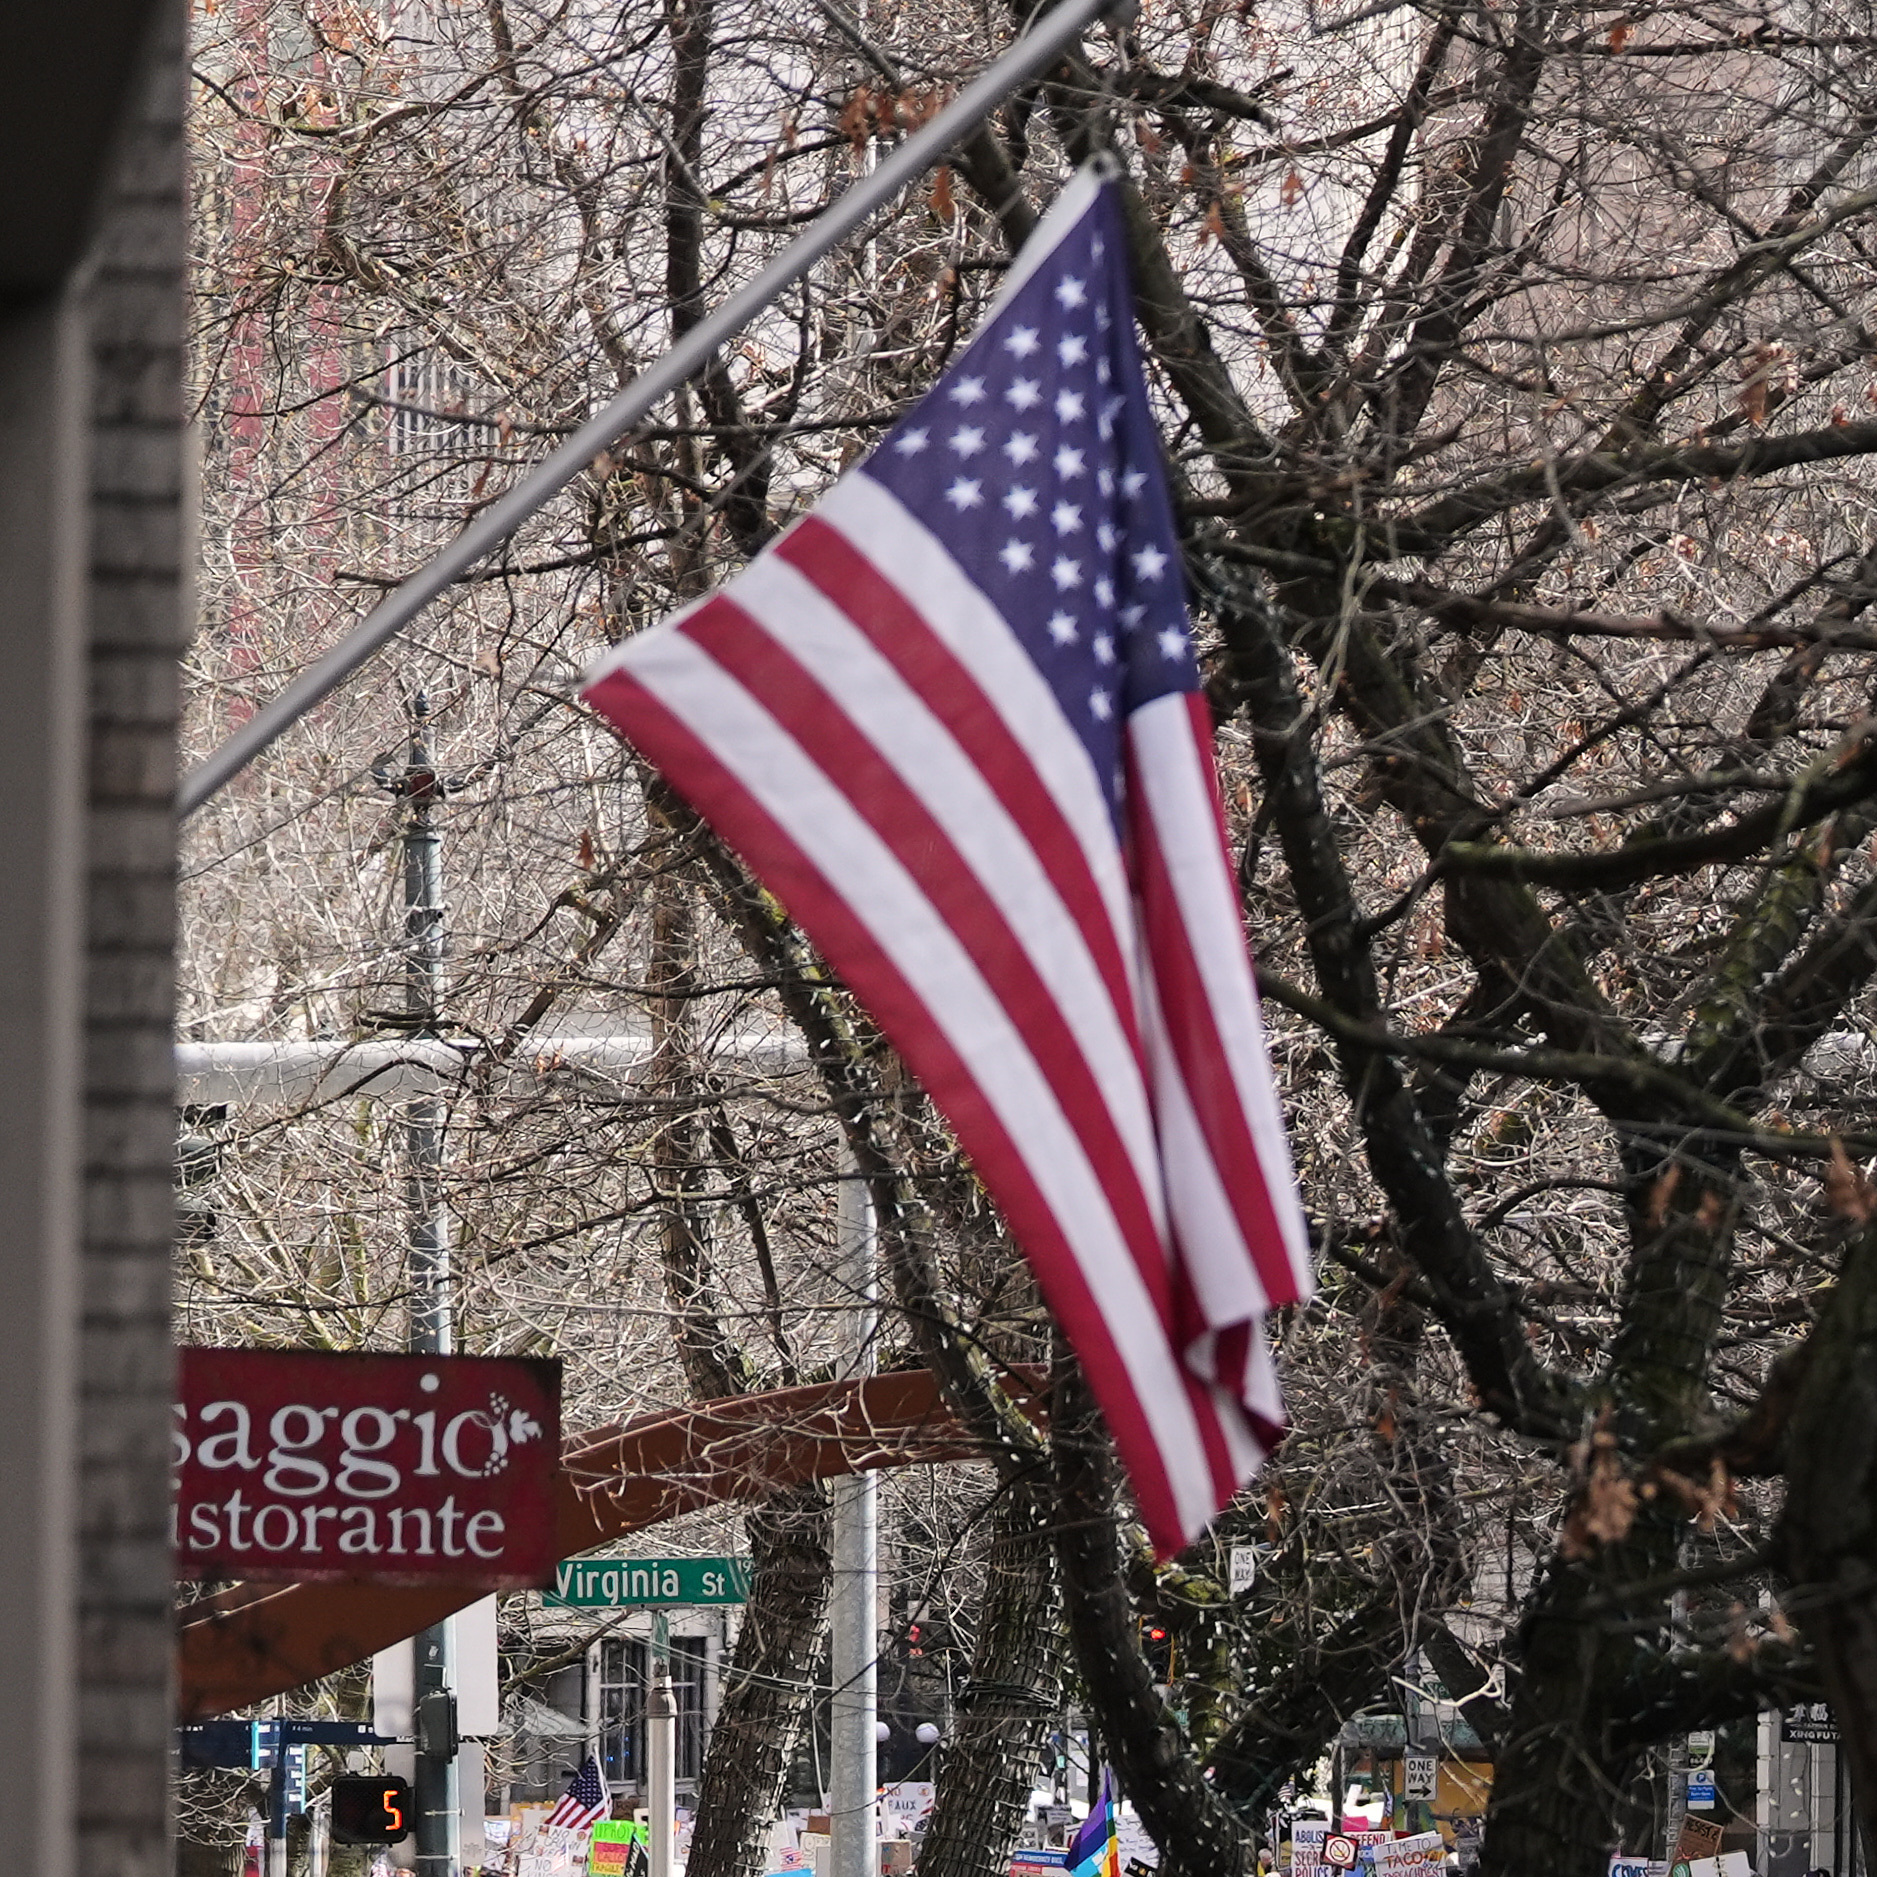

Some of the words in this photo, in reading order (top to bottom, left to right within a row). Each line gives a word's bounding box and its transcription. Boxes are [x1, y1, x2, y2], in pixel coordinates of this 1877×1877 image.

[555, 1561, 679, 1605] Virginia
[702, 1572, 725, 1595] St
[1408, 1760, 1433, 1771] ONE
[1408, 1773, 1435, 1784] WAY
[384, 1790, 402, 1830] 5
[1384, 1852, 1422, 1868] TACO
